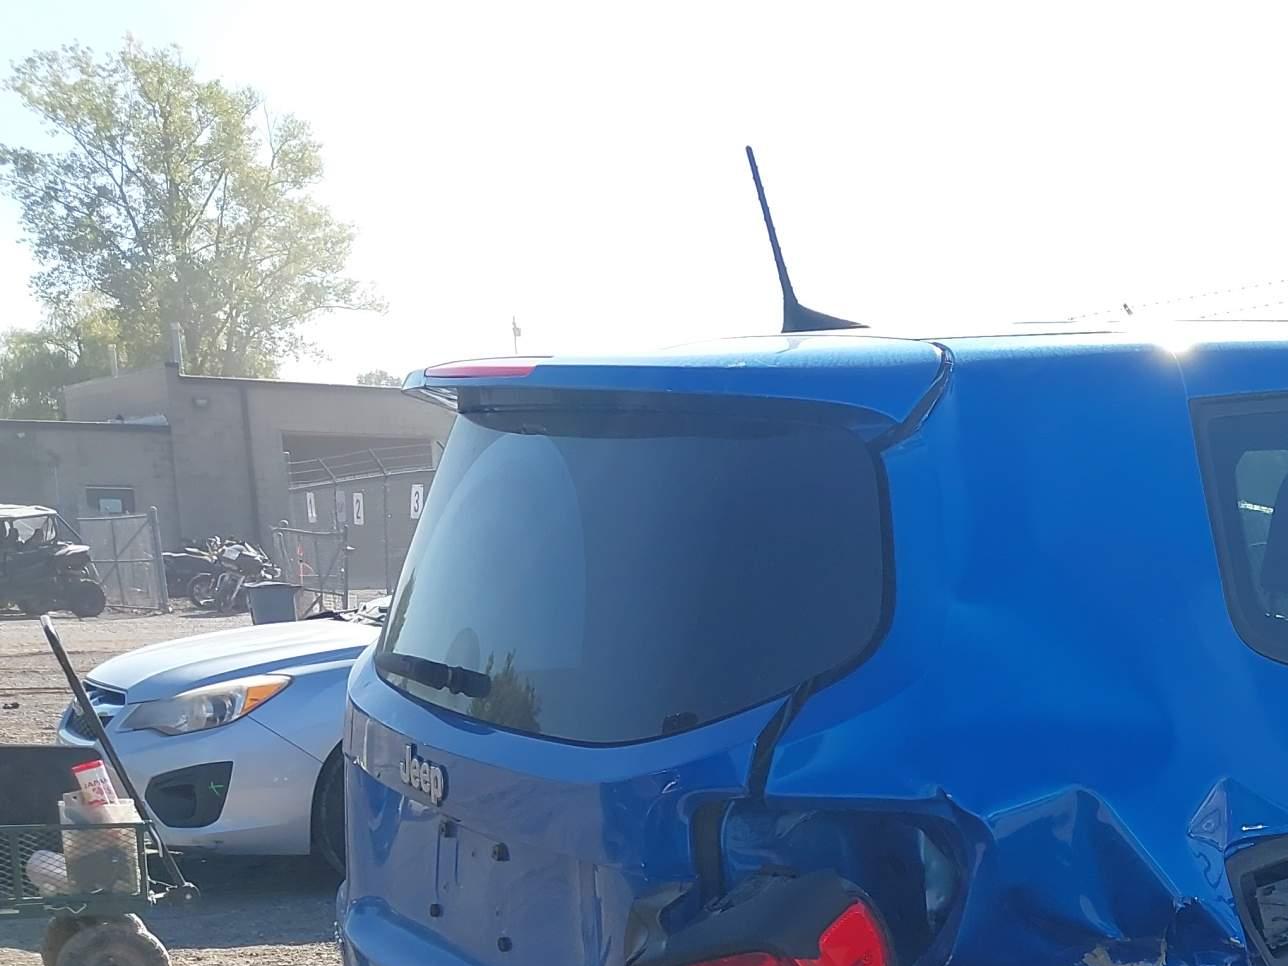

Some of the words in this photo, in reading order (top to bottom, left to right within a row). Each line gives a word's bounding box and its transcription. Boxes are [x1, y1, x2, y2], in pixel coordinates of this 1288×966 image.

[355, 499, 362, 520] 2
[414, 490, 421, 513] 3
[400, 744, 445, 805] Jeep
